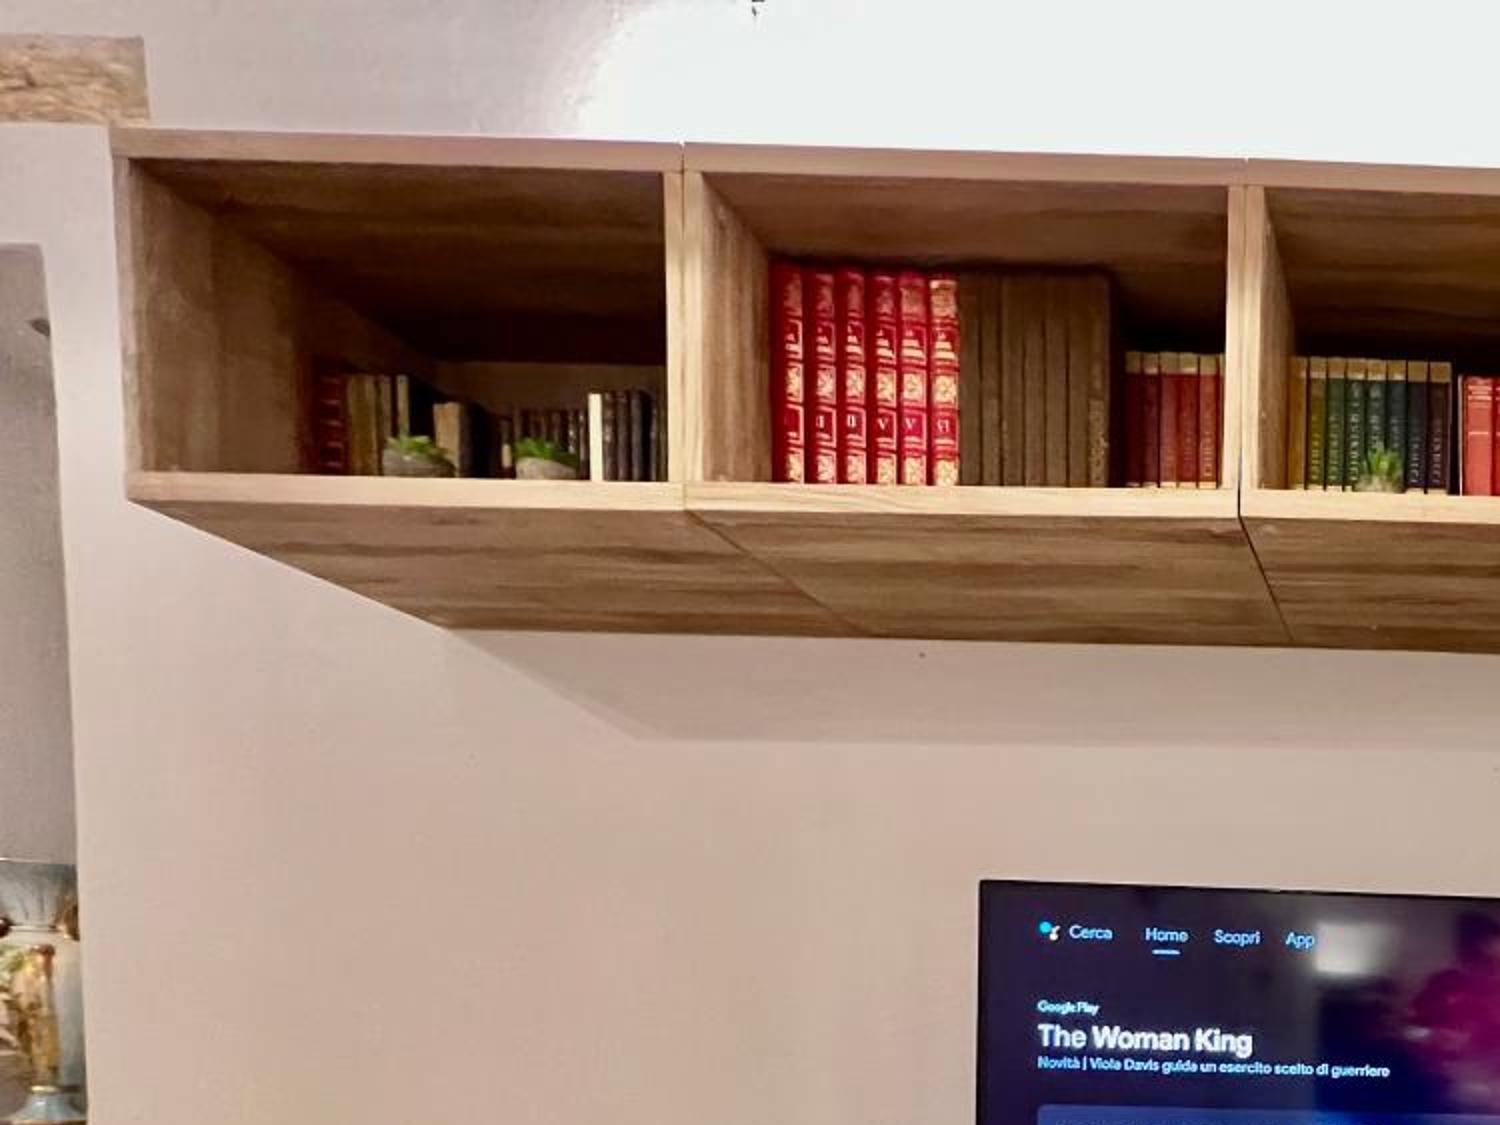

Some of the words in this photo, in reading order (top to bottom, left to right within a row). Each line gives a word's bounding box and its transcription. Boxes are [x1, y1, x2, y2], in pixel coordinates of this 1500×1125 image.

[1068, 923, 1113, 940] Cerca
[1144, 927, 1189, 943] Home
[1214, 929, 1261, 949] Scopri
[1285, 931, 1316, 950] App
[1037, 1000, 1075, 1015] Google
[1076, 1001, 1100, 1016] Play
[1037, 1024, 1087, 1047] The
[1091, 1025, 1190, 1051] Woman
[1195, 1027, 1254, 1059] King
[1090, 1057, 1121, 1071] Viola
[1123, 1058, 1160, 1071] Davis
[1161, 1060, 1198, 1074] guida
[1200, 1062, 1217, 1073] un
[1219, 1061, 1273, 1075] esercito
[1273, 1063, 1315, 1075] scelto
[1315, 1063, 1329, 1076] di
